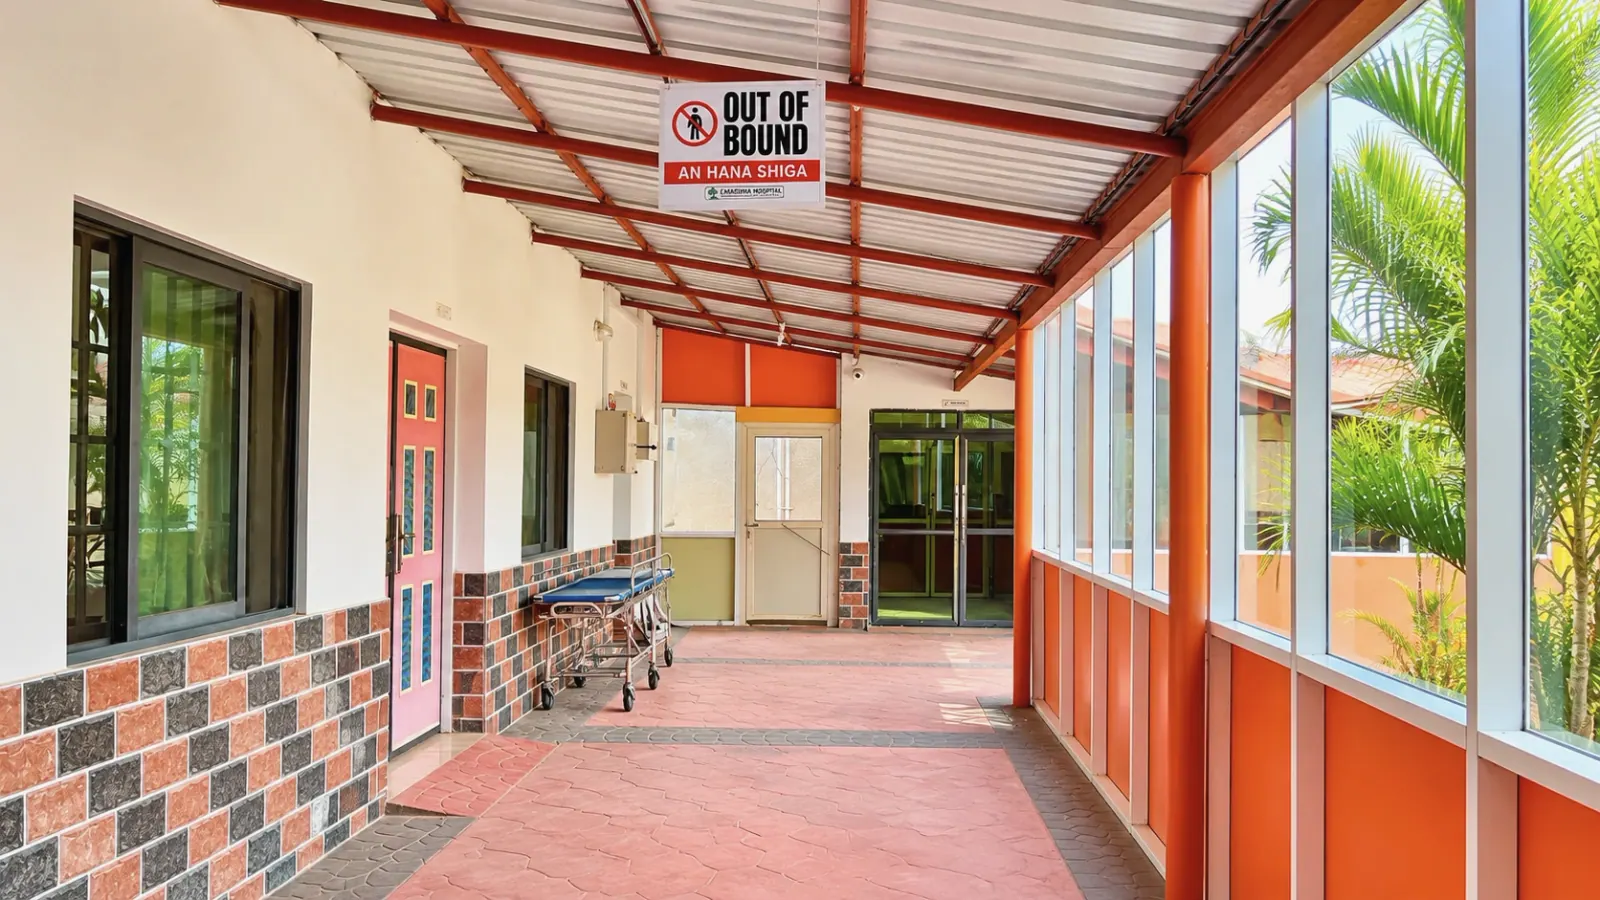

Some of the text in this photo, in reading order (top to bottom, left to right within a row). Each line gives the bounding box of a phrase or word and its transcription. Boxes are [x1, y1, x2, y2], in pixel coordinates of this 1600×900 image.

[723, 90, 809, 123] OUT OF
[723, 123, 808, 156] BOUND
[678, 163, 808, 180] AN HANA SHIGA
